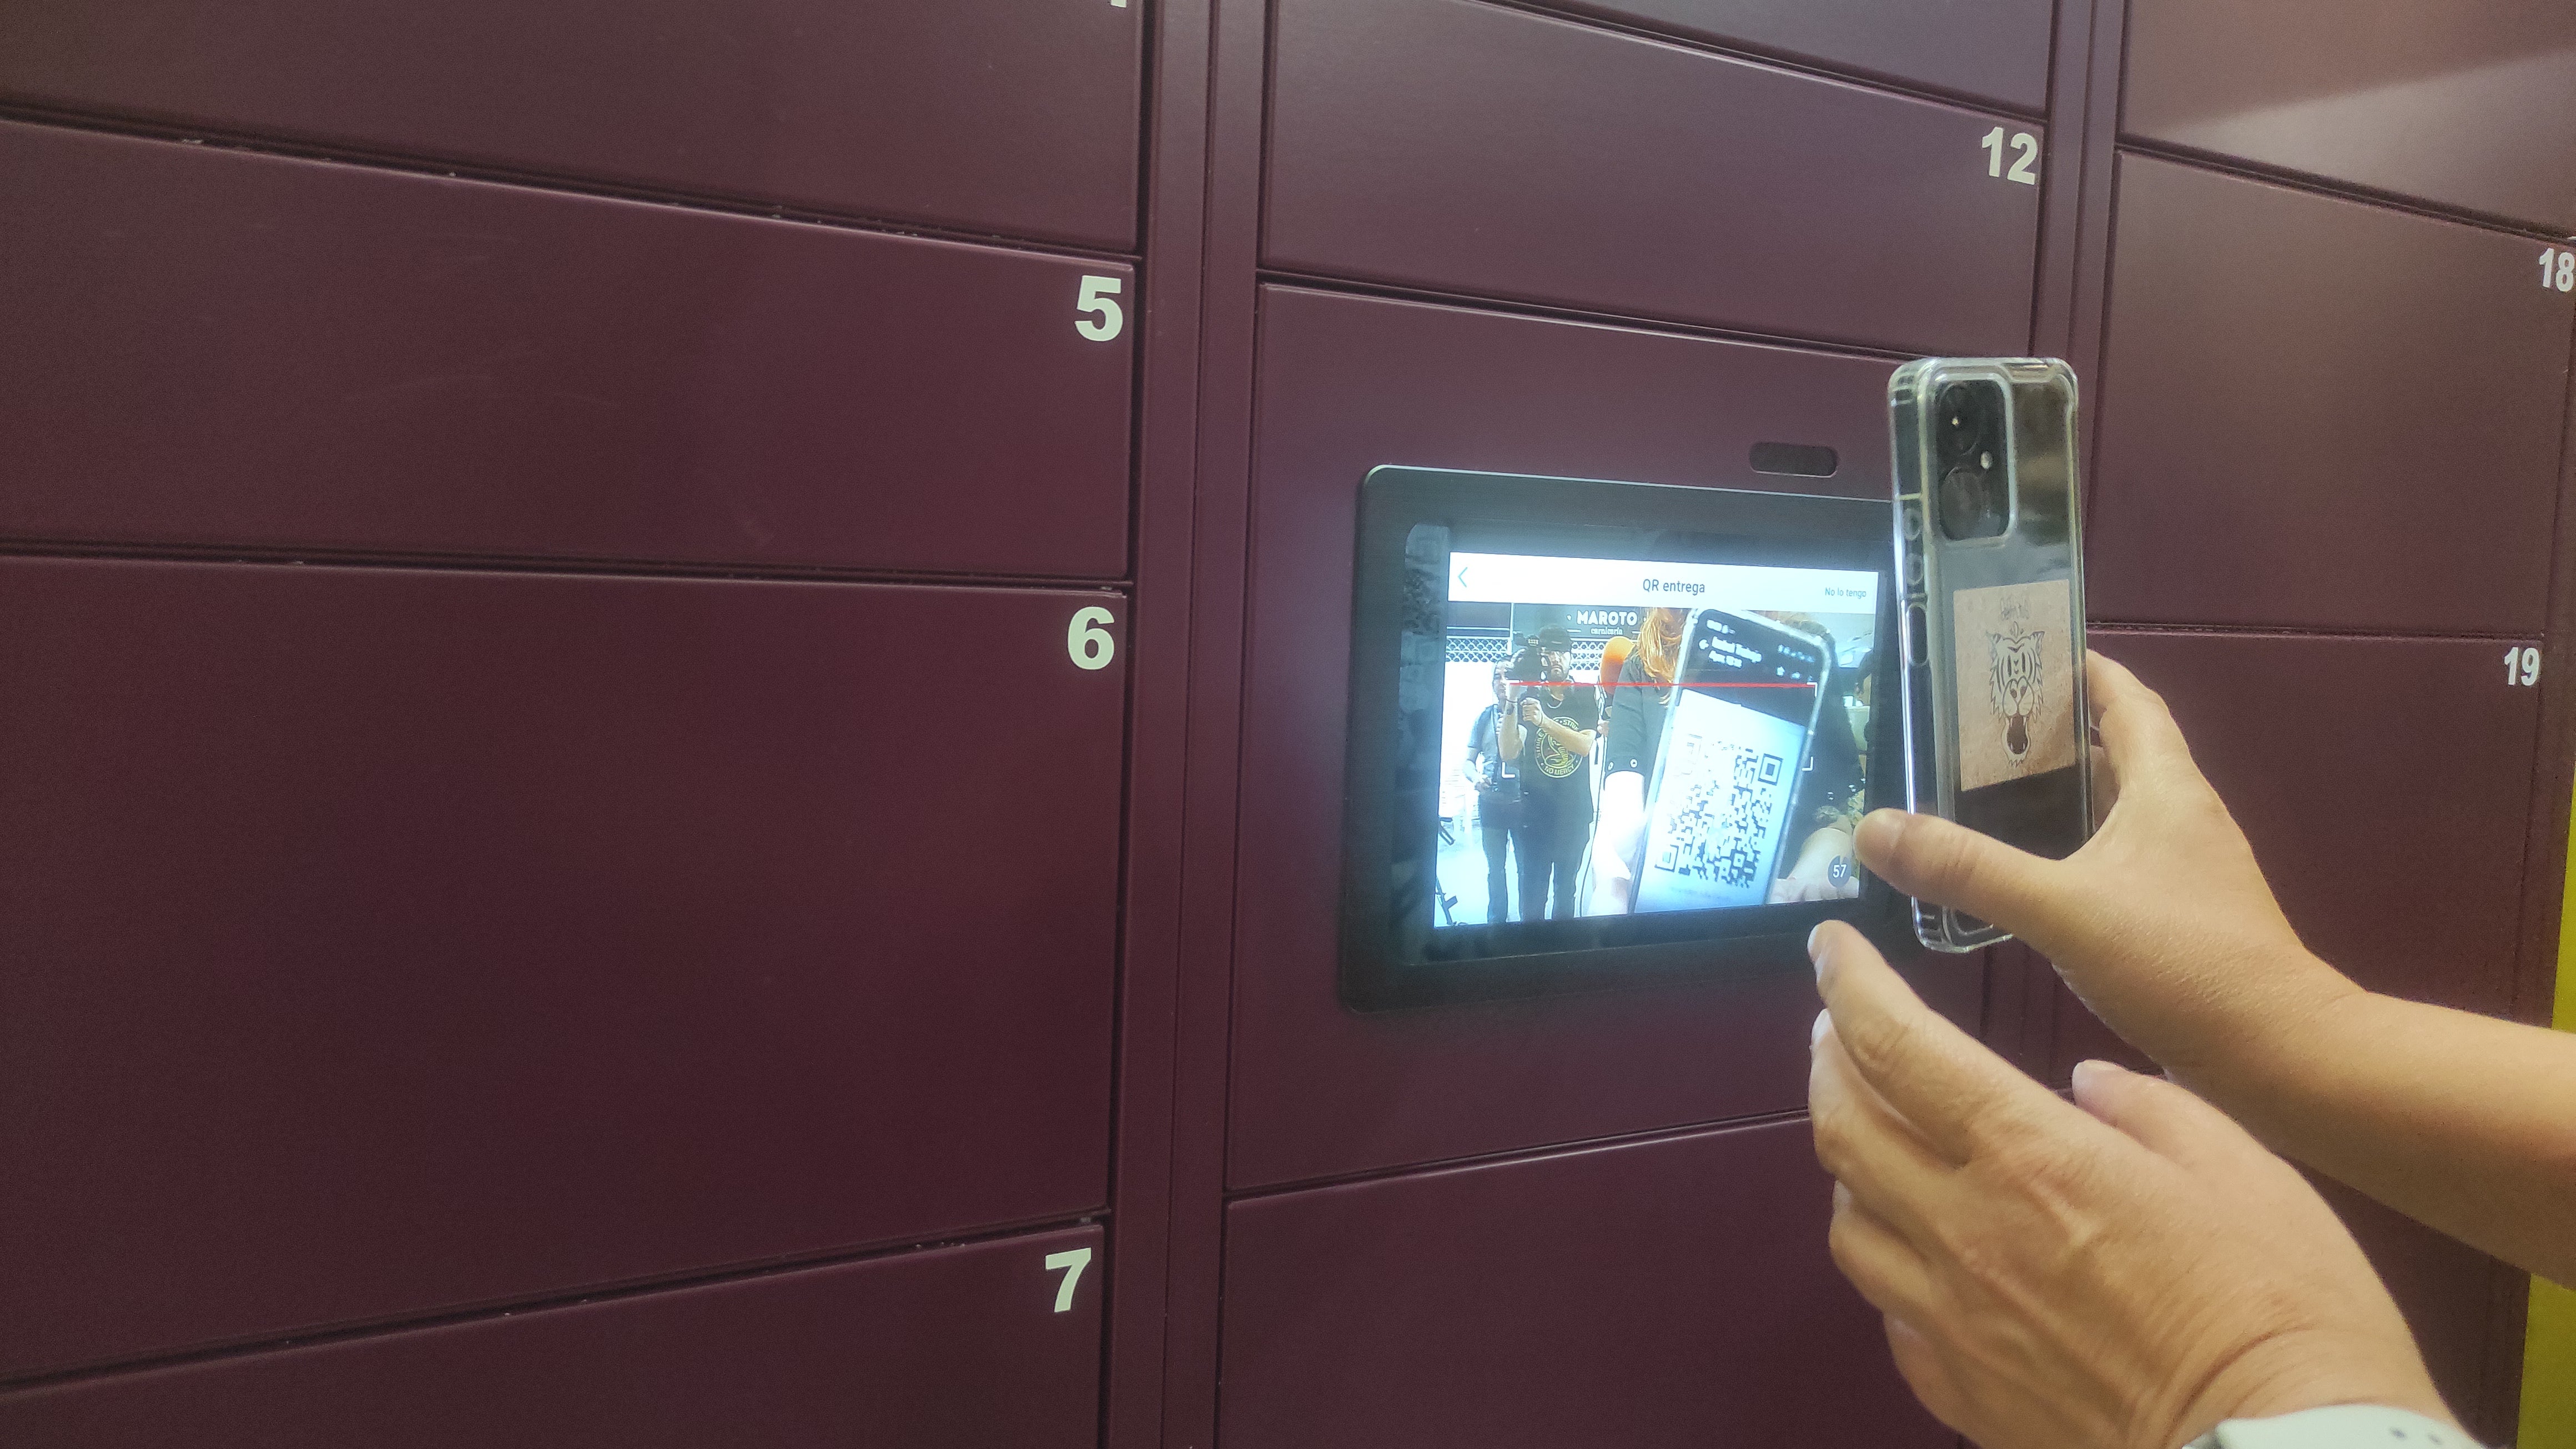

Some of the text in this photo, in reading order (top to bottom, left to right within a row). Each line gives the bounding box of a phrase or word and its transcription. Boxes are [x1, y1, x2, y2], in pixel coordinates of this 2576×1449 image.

[1981, 126, 2037, 185] 12
[2539, 248, 2575, 292] 18
[1074, 275, 1123, 342] 5
[1643, 578, 1705, 596] QR entrega
[1825, 587, 1866, 600] No lo tengo
[1068, 606, 1115, 670] 6
[1577, 610, 1638, 626] MAROTO
[2504, 647, 2539, 686] 19
[1833, 864, 1847, 878] 57
[1045, 1247, 1091, 1312] 7
